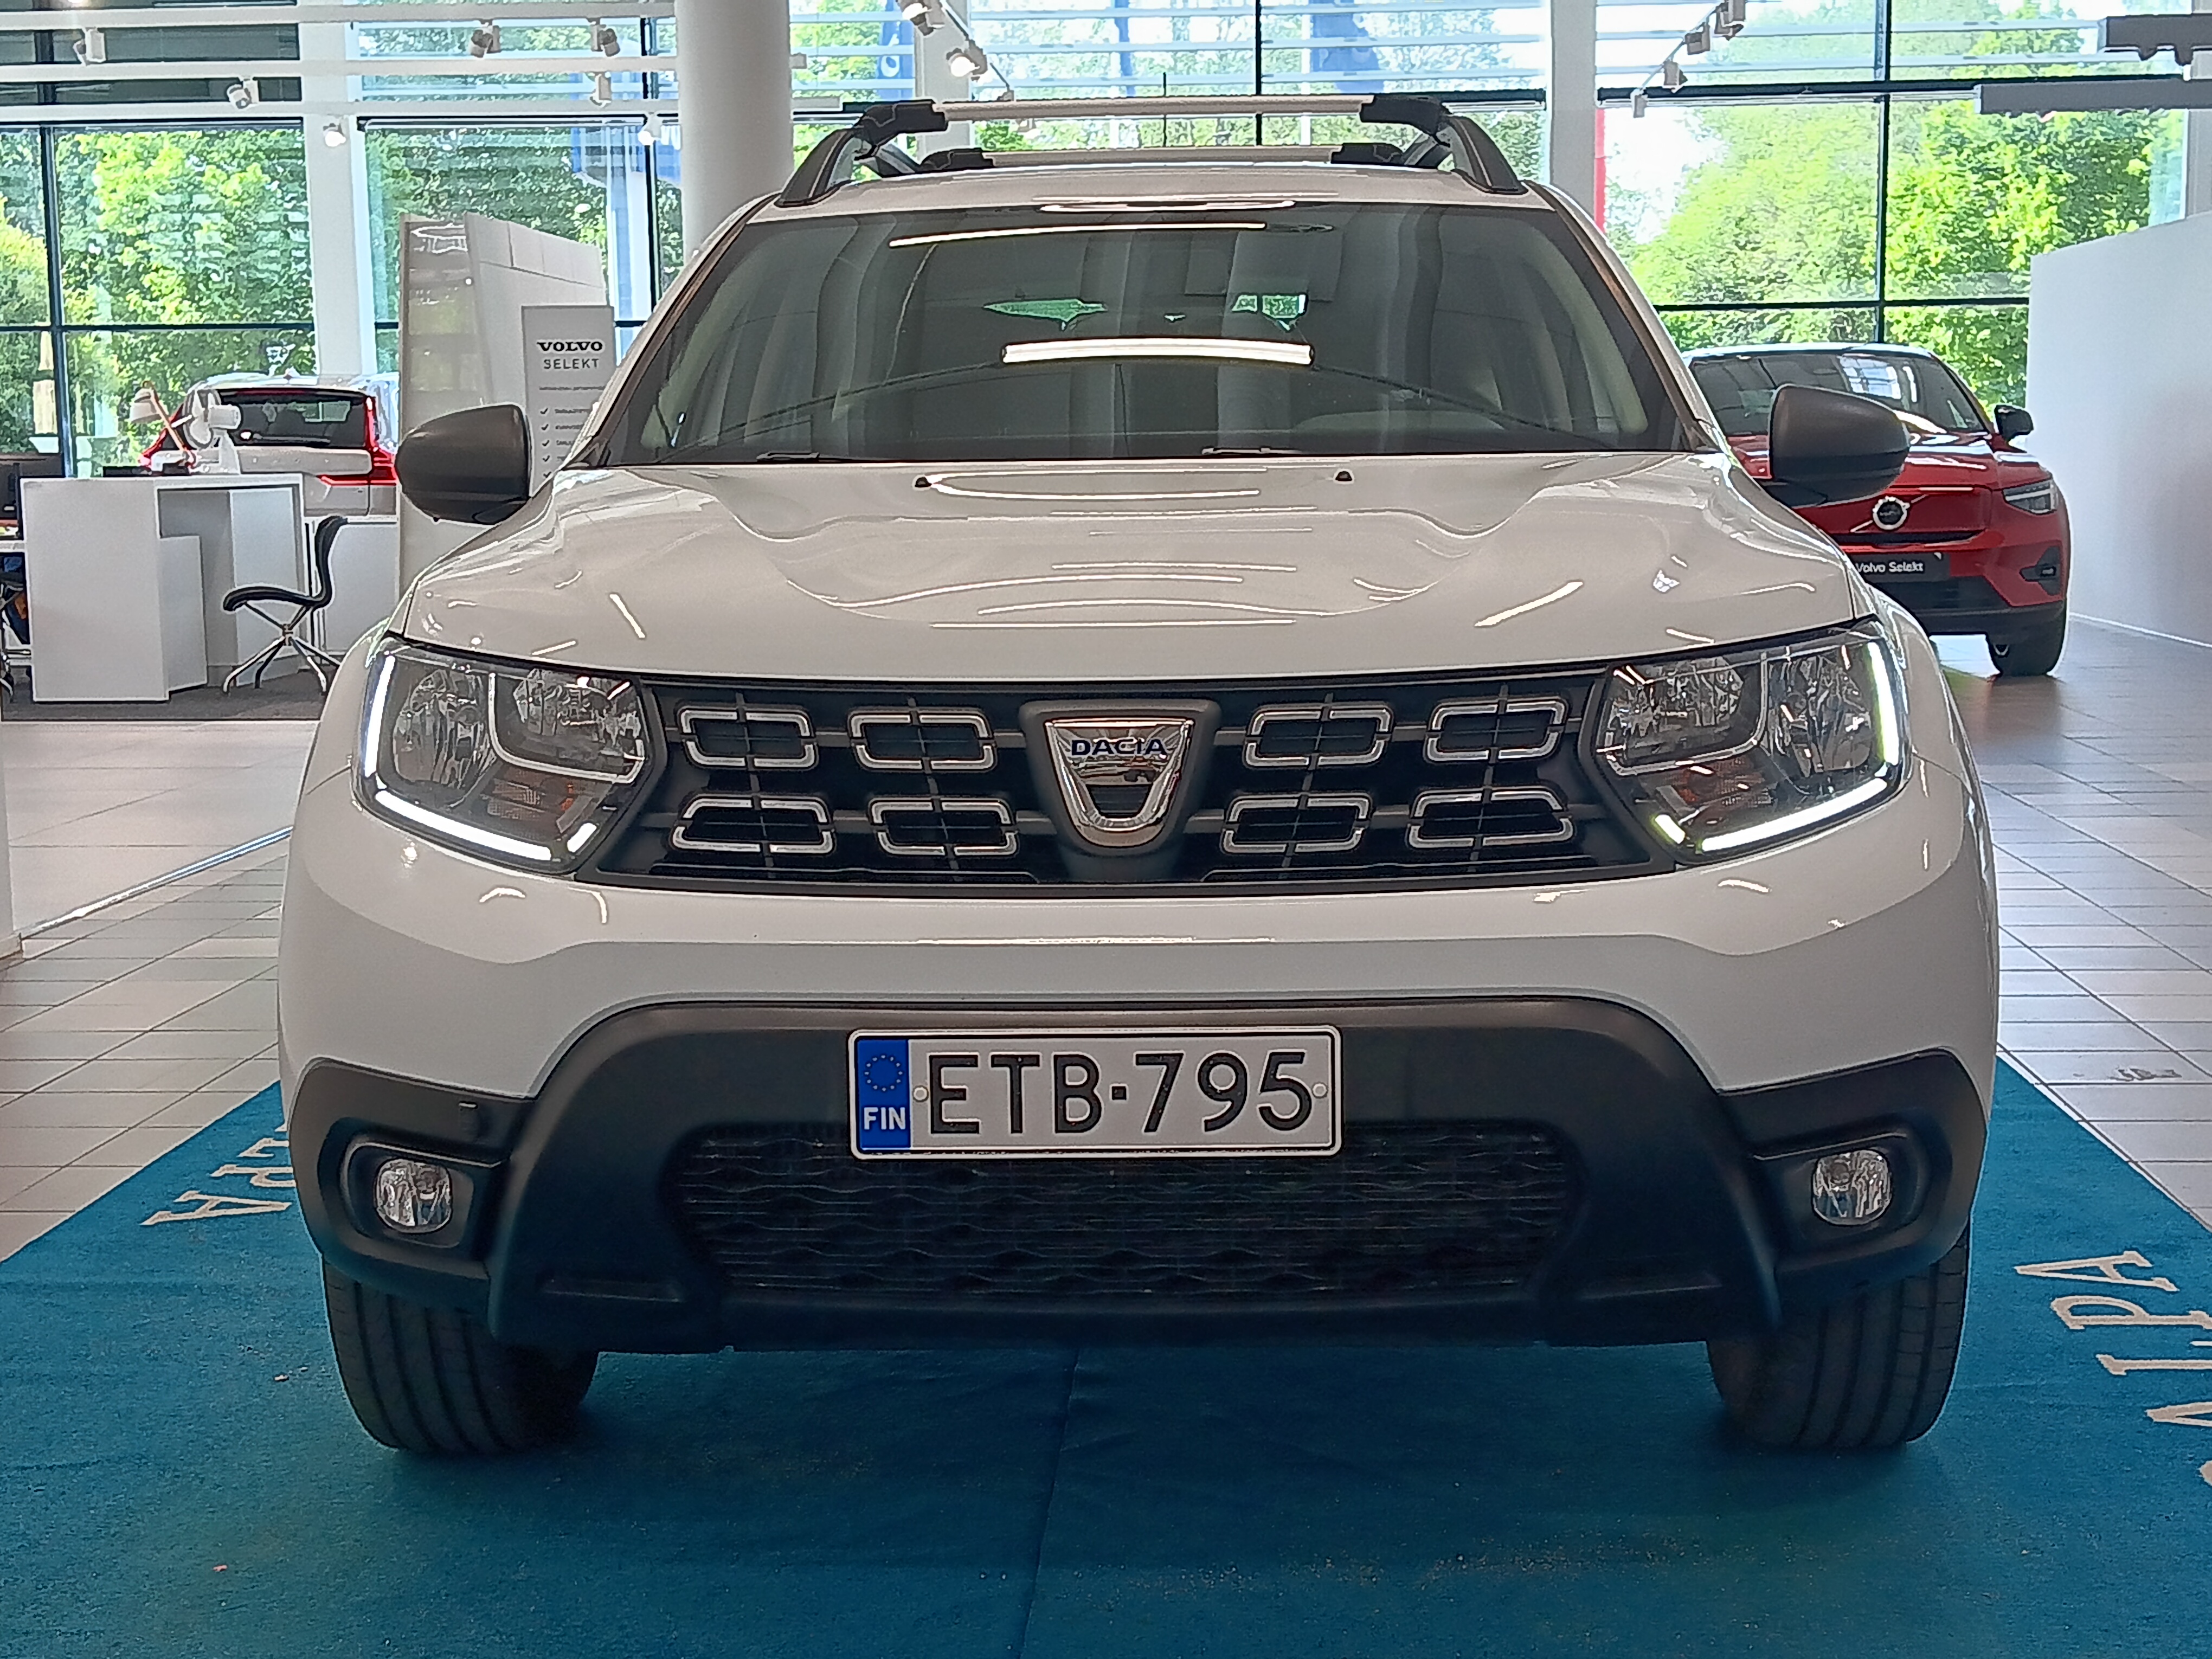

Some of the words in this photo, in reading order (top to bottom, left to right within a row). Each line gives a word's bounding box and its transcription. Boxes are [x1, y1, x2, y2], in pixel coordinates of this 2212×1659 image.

[537, 341, 603, 352] VOLVO
[543, 358, 600, 369] SELEKT
[1855, 562, 1886, 574] Volvo
[1888, 561, 1924, 573] Selekt
[1070, 738, 1168, 756] DACIA
[863, 1107, 906, 1131] FIN
